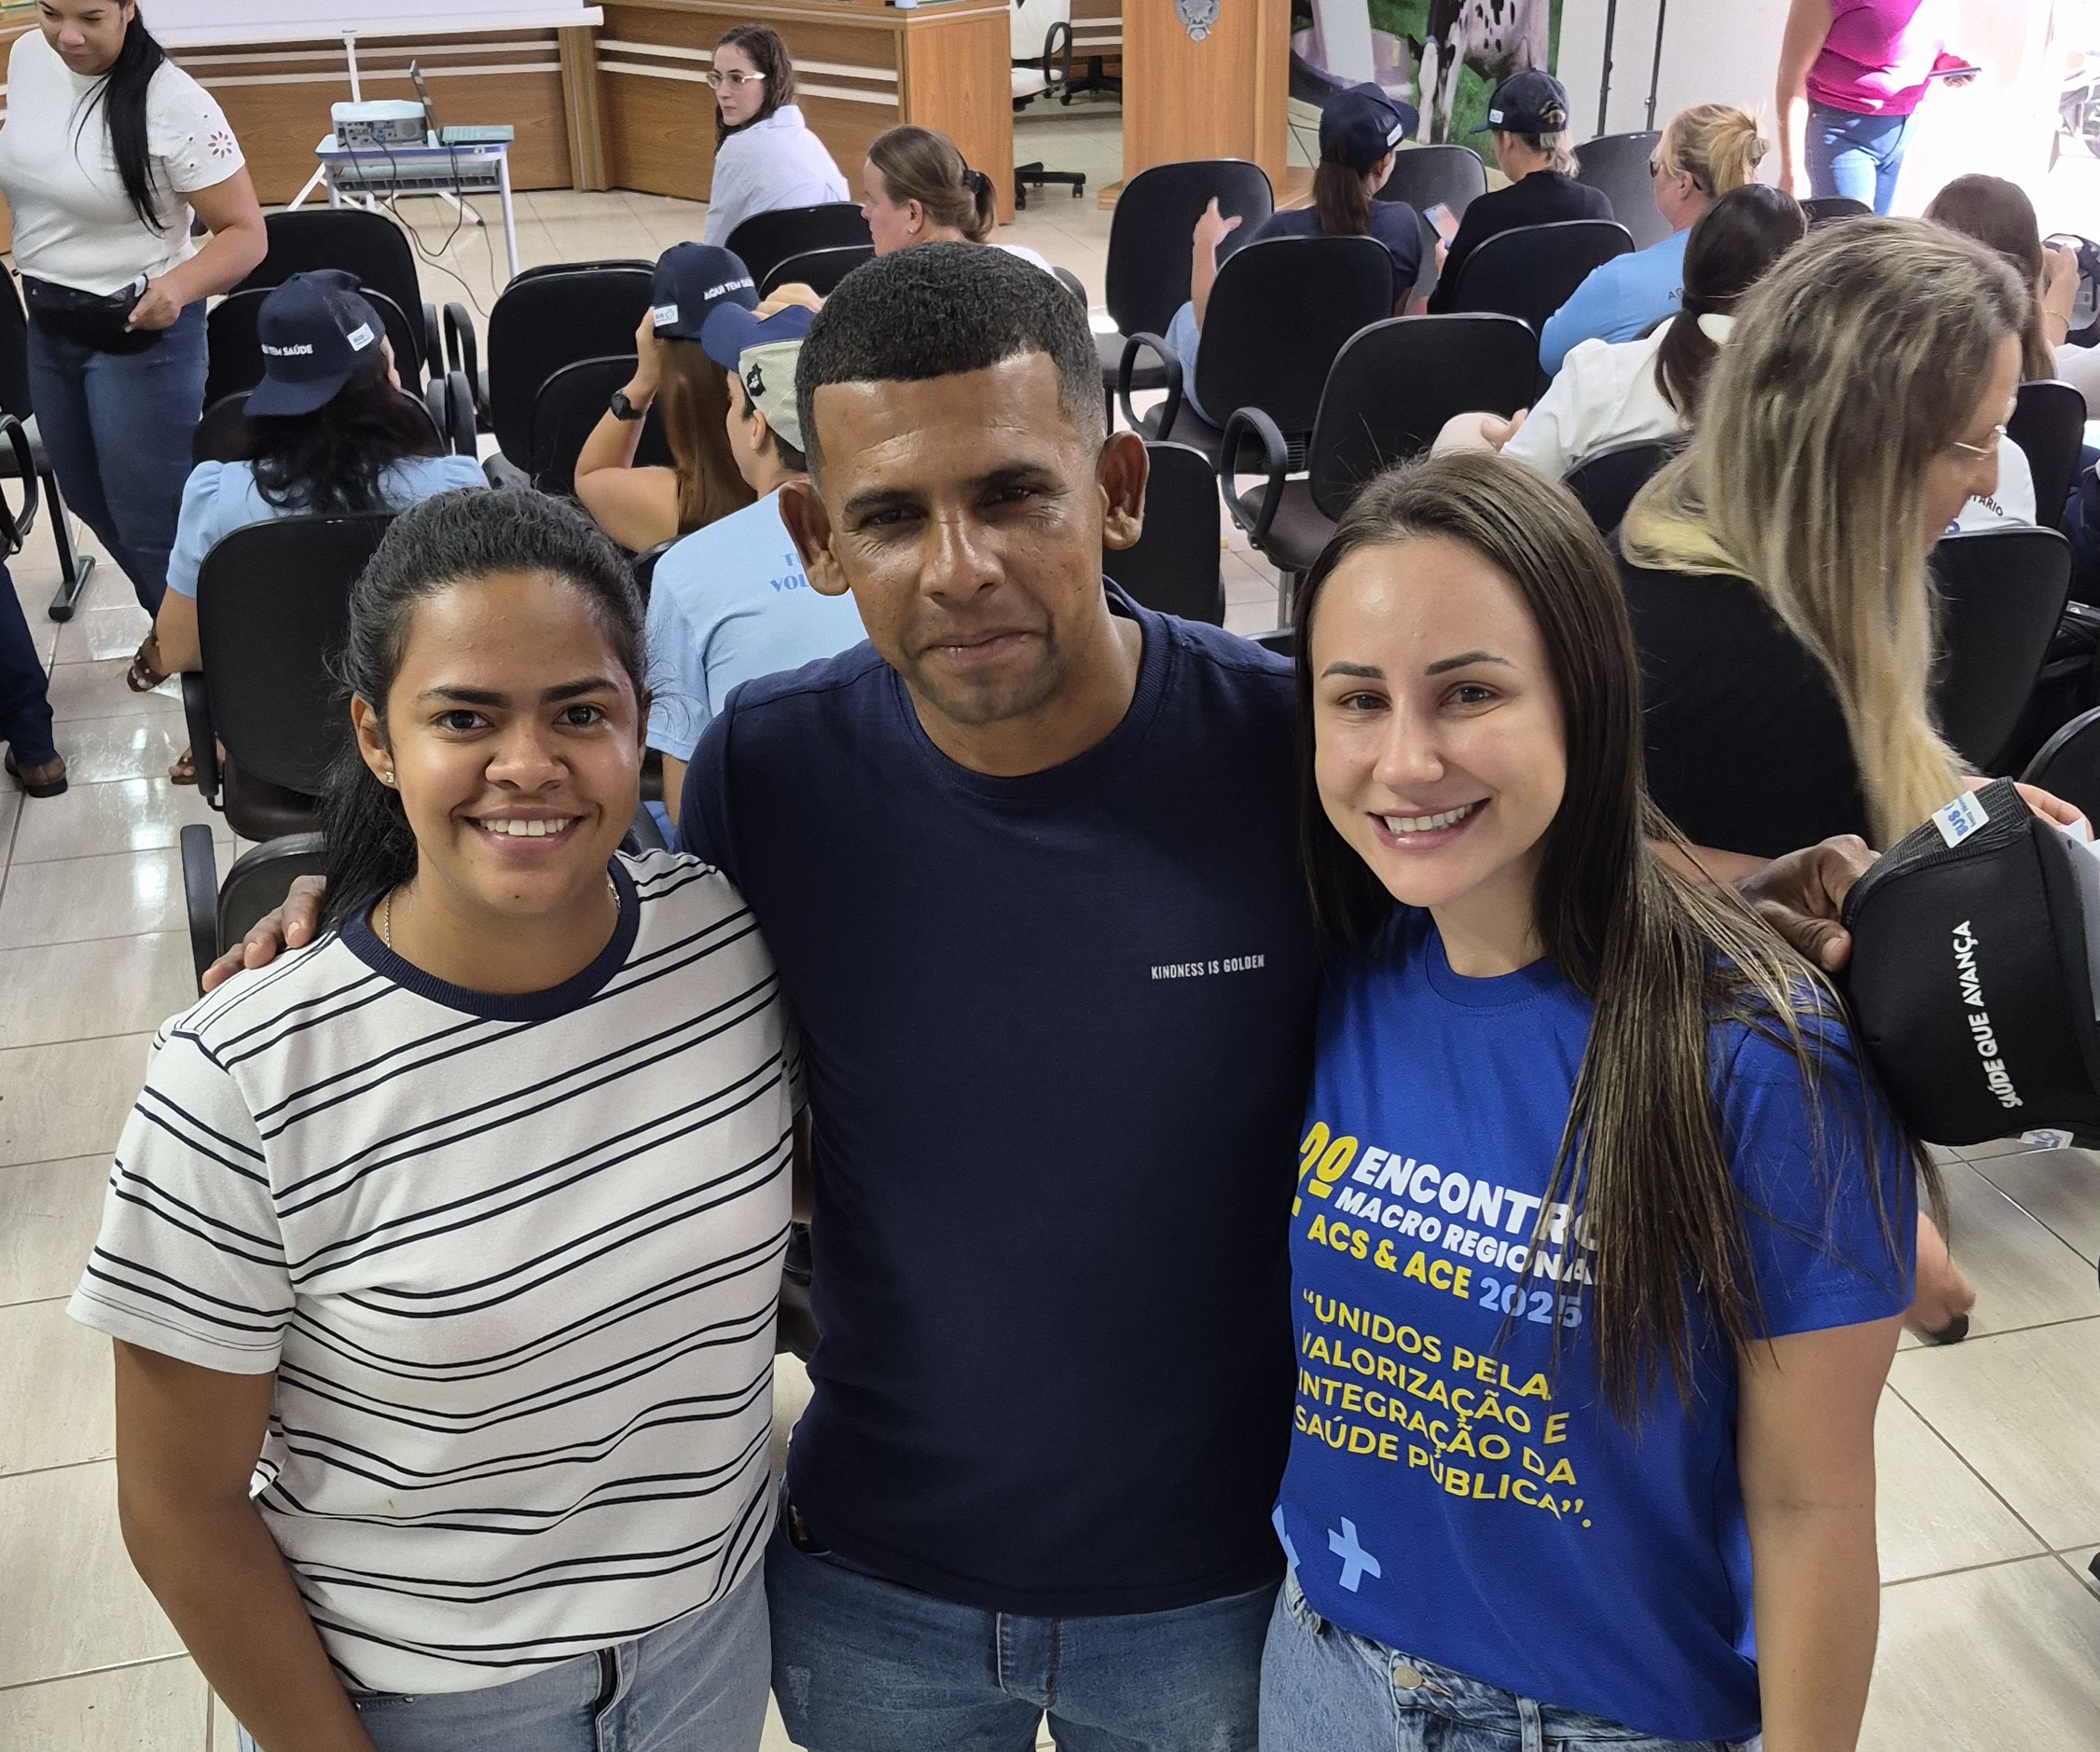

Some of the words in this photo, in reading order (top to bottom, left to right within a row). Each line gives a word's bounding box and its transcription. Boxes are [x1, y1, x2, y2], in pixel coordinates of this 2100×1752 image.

[703, 285, 725, 300] AQUI
[283, 343, 313, 355] SAÚDE
[1151, 962, 1205, 979] KINDNESS
[1208, 960, 1220, 974] IS
[1223, 954, 1265, 973] GOLDEN
[1951, 919, 1984, 1007] AVANÇA
[1968, 1012, 1998, 1057] QUE
[1983, 1058, 2024, 1108] SAÚDE
[1333, 1186, 1442, 1242] MACRO
[1442, 1223, 1594, 1286] REGIONA
[1307, 1214, 1370, 1260] ACS
[1374, 1238, 1398, 1273] &
[1402, 1250, 1472, 1300] ACE
[1479, 1276, 1582, 1328] 2025
[1452, 1345, 1552, 1401] PELA
[1294, 1405, 1399, 1461] SAÚDE
[1298, 1367, 1511, 1460] INTEGRAÇÃO
[1522, 1446, 1576, 1485] DA
[1543, 1412, 1569, 1444] E
